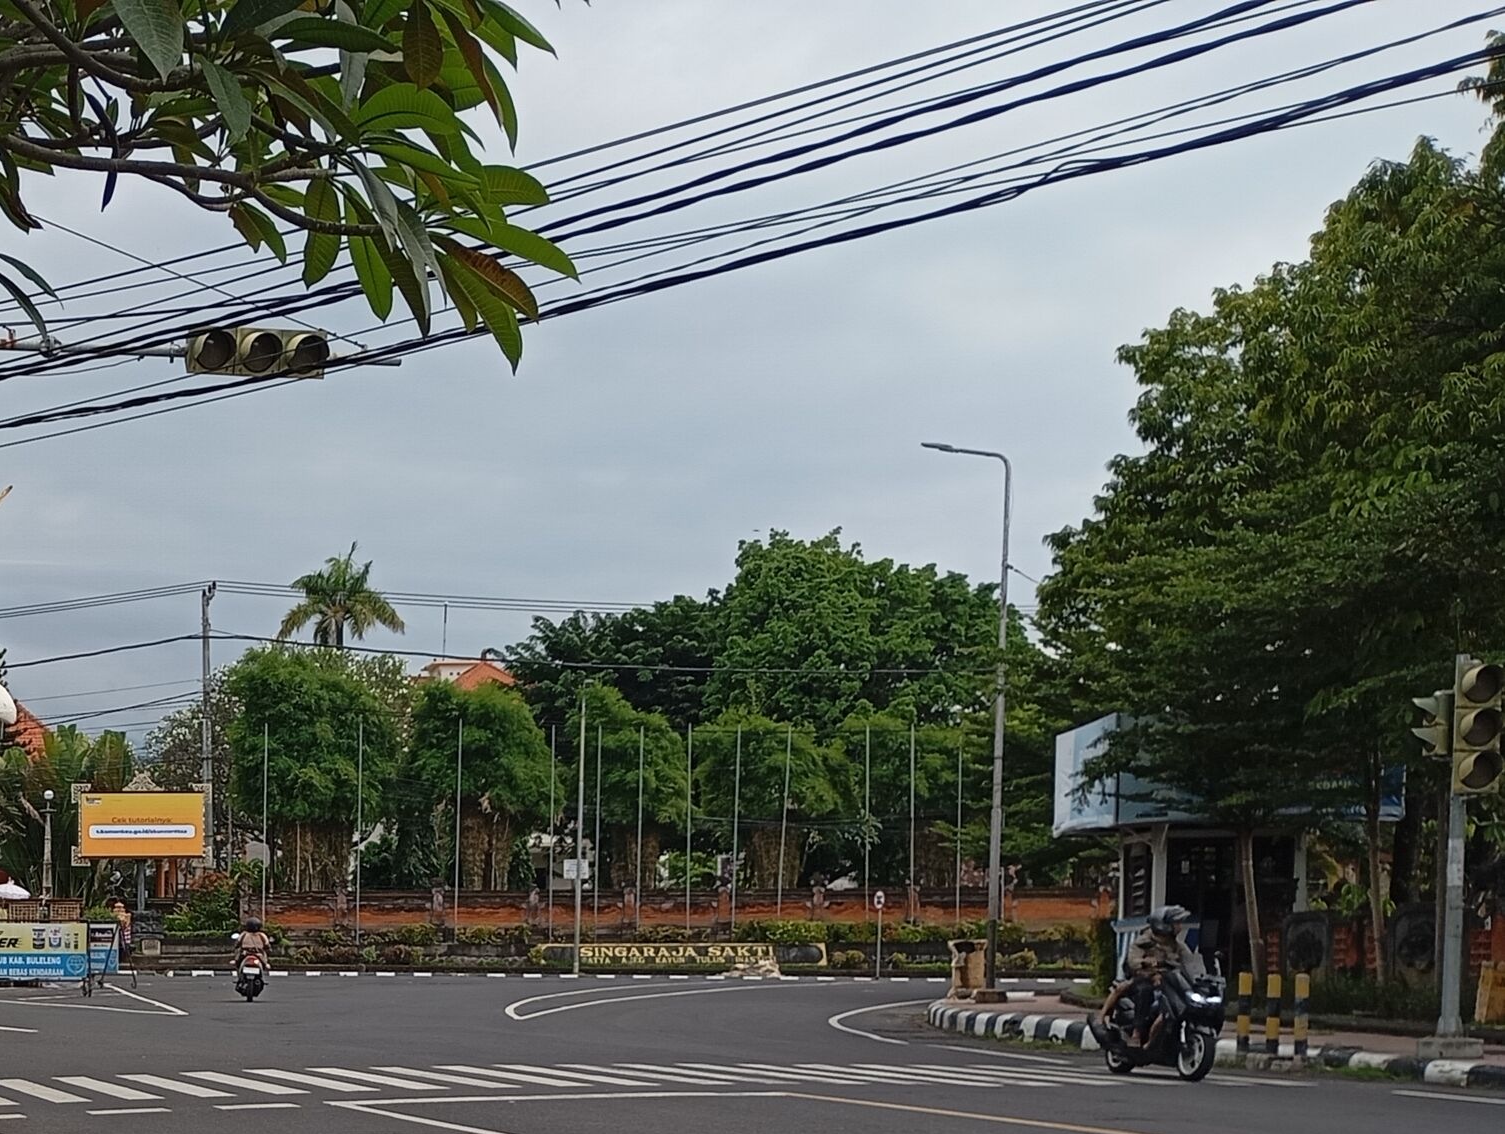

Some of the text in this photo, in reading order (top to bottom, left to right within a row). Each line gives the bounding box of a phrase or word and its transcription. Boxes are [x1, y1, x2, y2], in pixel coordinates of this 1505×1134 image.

[579, 946, 774, 957] SINGARAJA SAKTI
[26, 956, 62, 964] BULELENG
